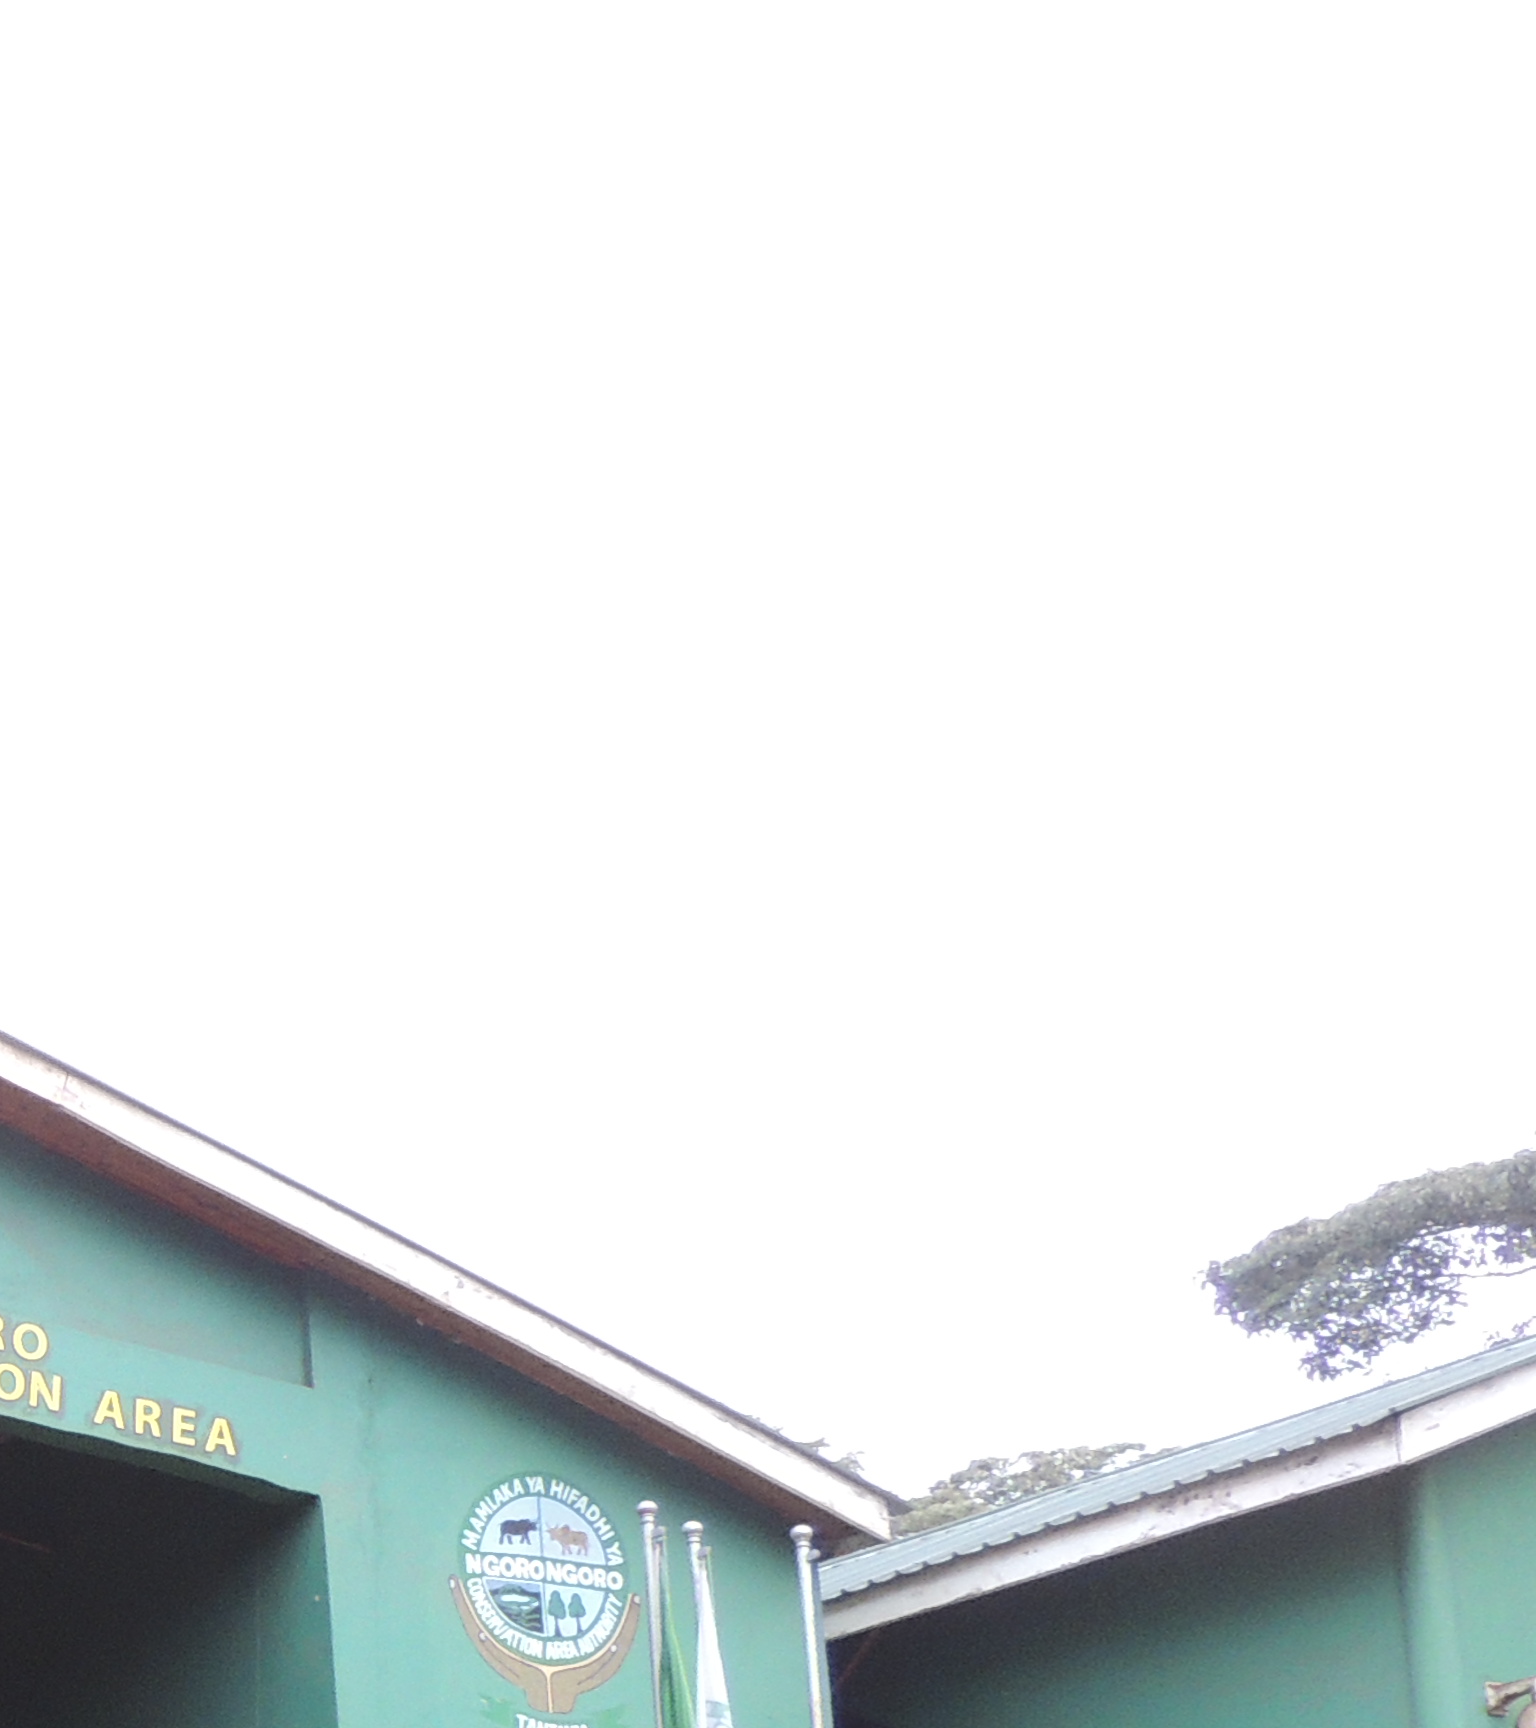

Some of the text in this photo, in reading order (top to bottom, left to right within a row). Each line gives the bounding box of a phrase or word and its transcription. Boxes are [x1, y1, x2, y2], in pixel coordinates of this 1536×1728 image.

[93, 1389, 237, 1457] AREA
[461, 1476, 624, 1567] MAMLAKA YA HIFADHI YA
[464, 1553, 624, 1590] NGORONGORO
[466, 1577, 543, 1659] CONSERVATION
[545, 1640, 580, 1660] AREA
